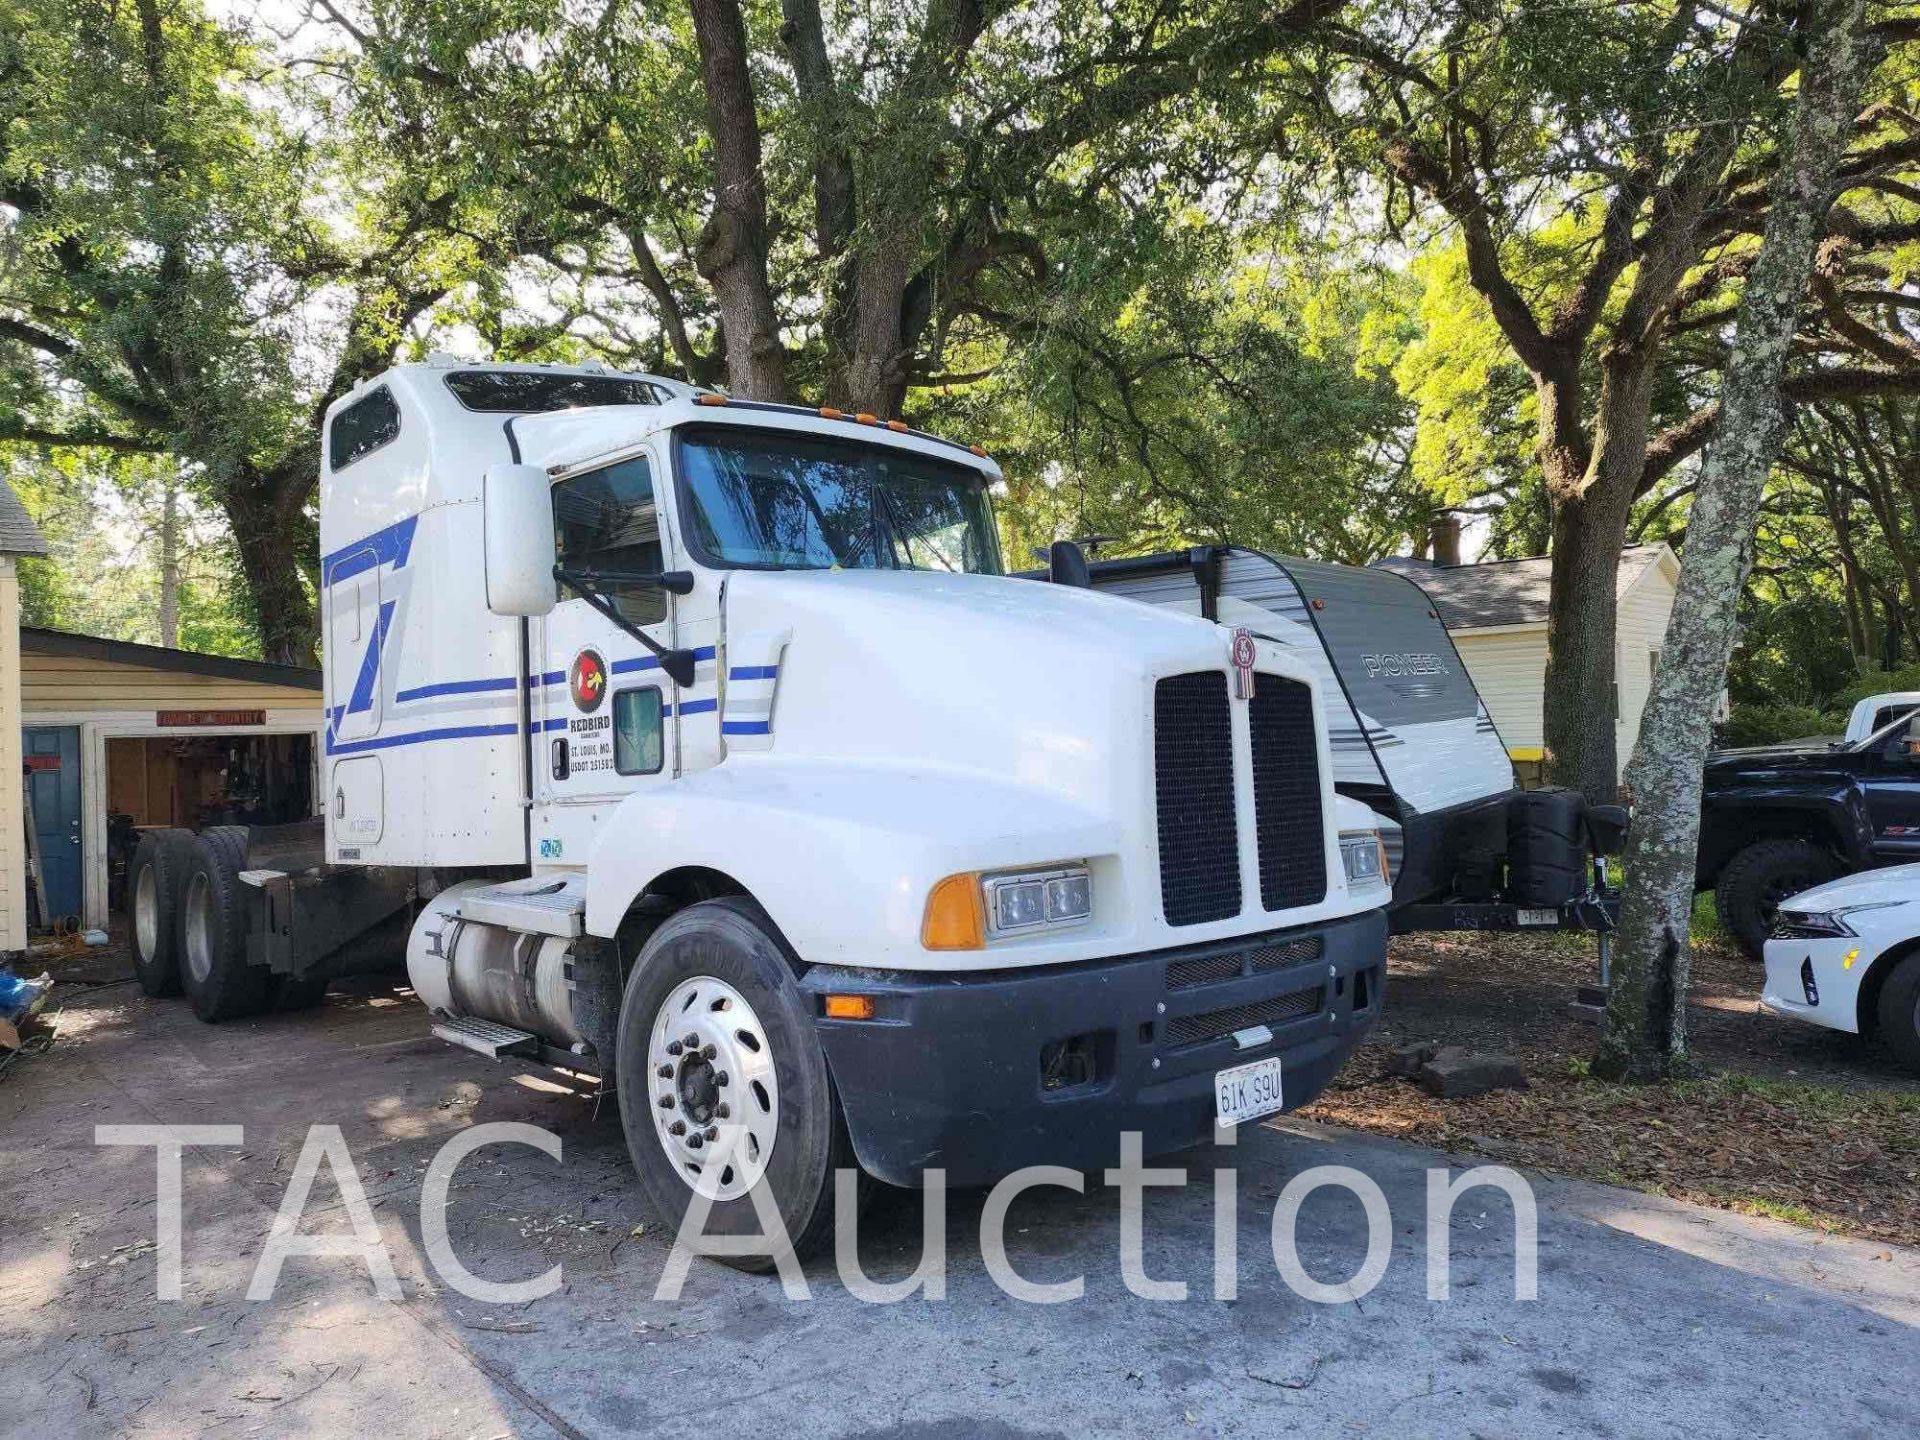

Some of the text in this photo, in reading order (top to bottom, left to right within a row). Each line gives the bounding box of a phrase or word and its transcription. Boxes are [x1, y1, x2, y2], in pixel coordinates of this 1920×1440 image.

[1361, 653, 1450, 677] PIONEER
[570, 716, 610, 732] REDBIRD
[571, 742, 612, 758] ST. LOUIS, MO.
[570, 760, 589, 772] USDOT
[1221, 1080, 1248, 1112] 61K
